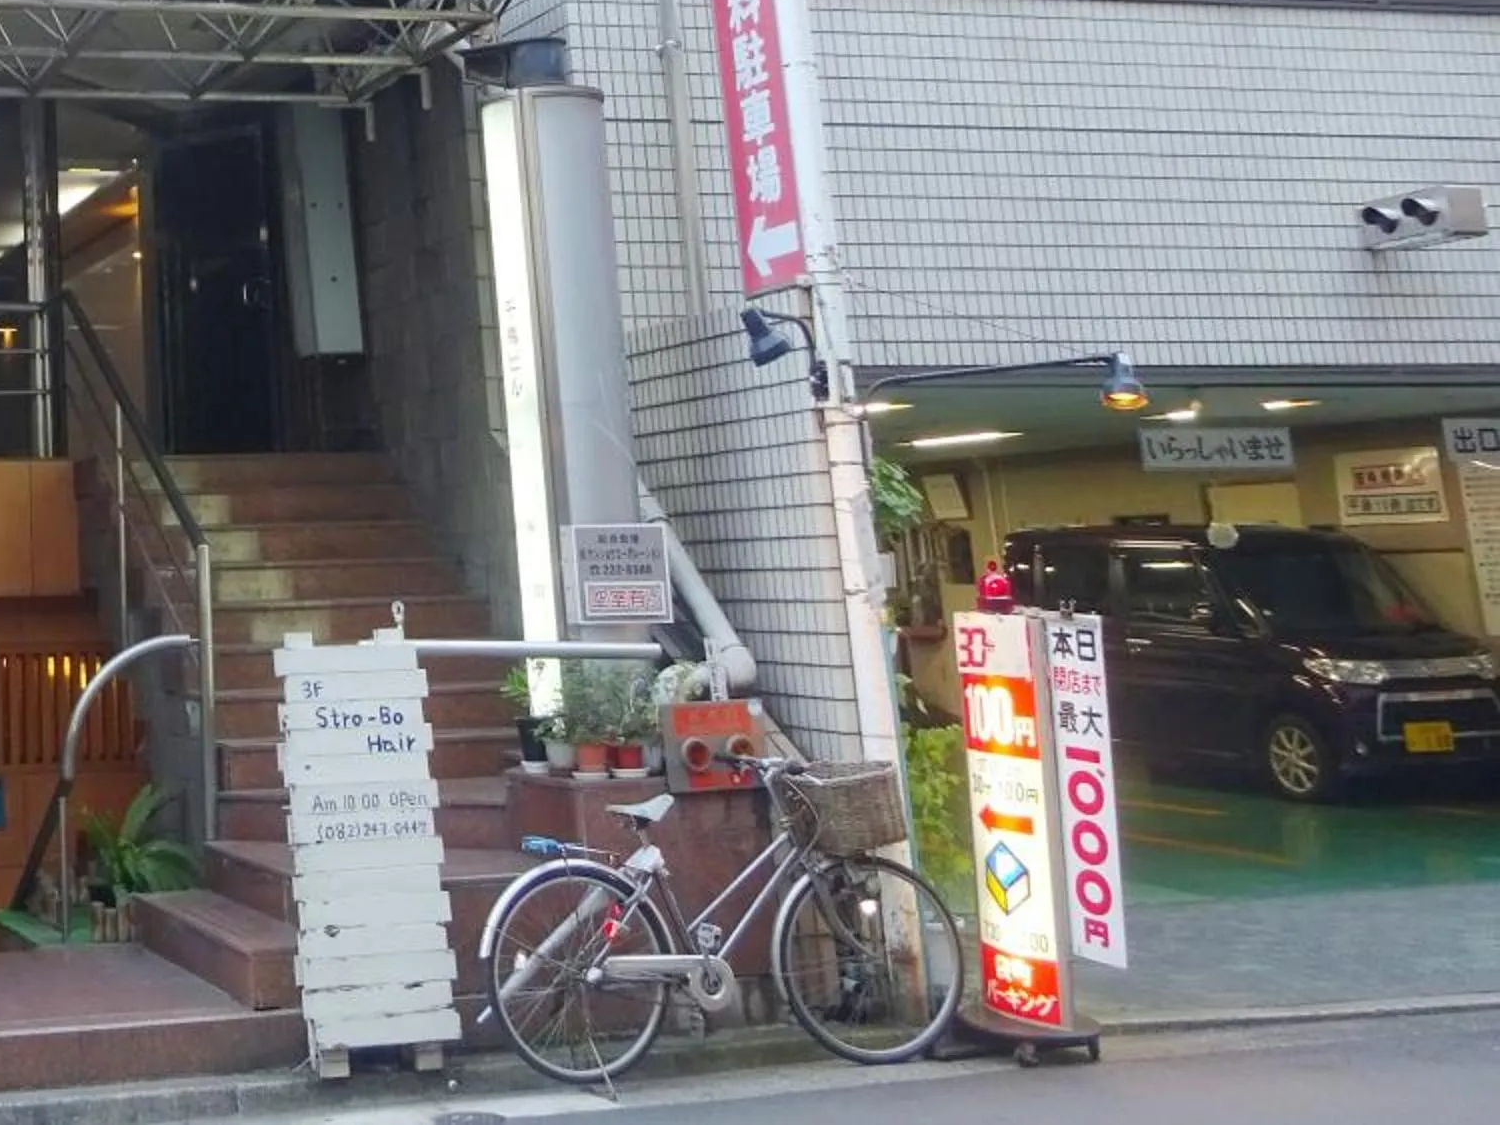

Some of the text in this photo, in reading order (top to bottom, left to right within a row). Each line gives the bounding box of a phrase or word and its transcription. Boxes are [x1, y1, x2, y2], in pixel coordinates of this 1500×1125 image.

[1146, 434, 1286, 463] いらっしゃいませ
[1453, 426, 1500, 453] 出口
[1052, 628, 1097, 662] 本日
[301, 681, 324, 699] 3F
[1053, 666, 1101, 698] 閉店まで
[315, 706, 404, 729] Stro-Bo
[963, 683, 1037, 751] 100円
[1058, 700, 1104, 738] 最大
[367, 733, 416, 755] Hair
[987, 978, 1060, 1017] パーキング
